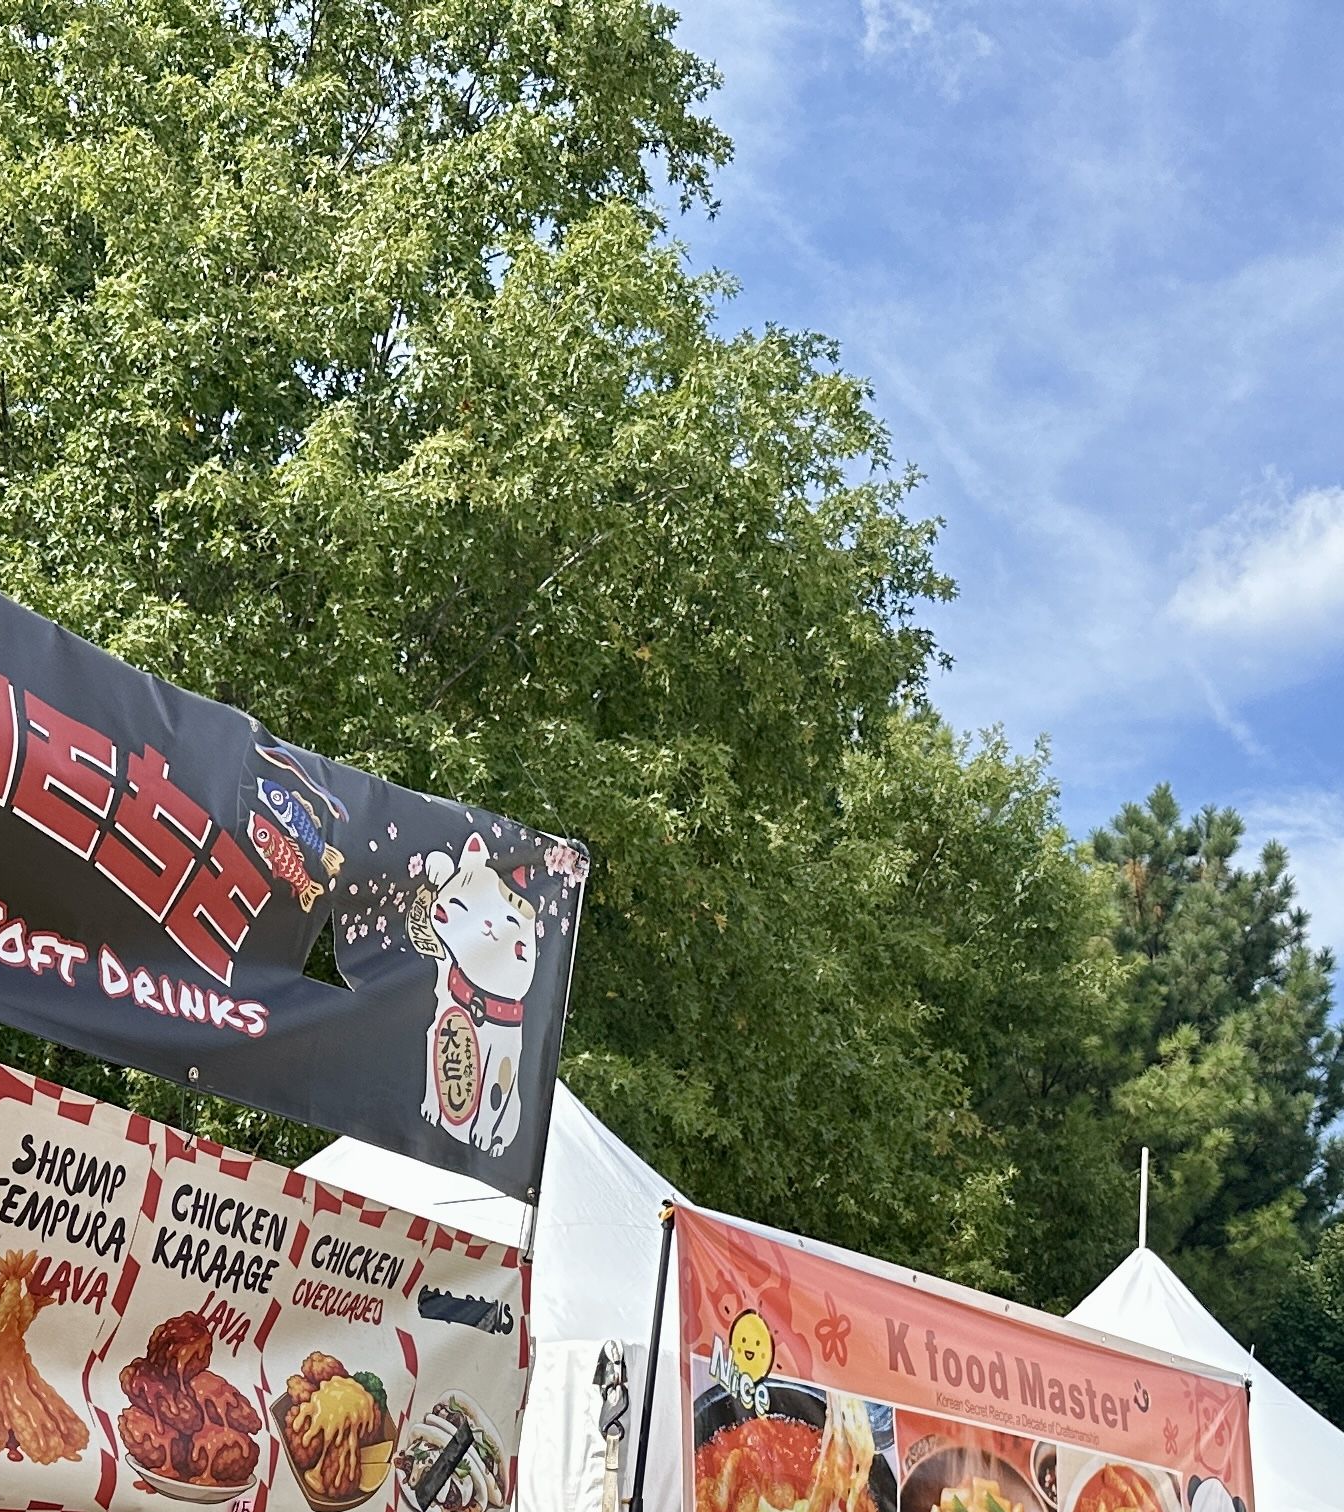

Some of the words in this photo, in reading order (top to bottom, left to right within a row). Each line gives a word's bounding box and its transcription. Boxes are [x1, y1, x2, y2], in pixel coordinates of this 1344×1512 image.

[98, 947, 268, 1035] DRINKS
[11, 1134, 128, 1204] SHRIMP
[170, 1183, 290, 1253] CHICKEN
[28, 1256, 109, 1316] LAVA
[151, 1226, 282, 1296] KARAAGE
[310, 1234, 405, 1291] CHICKEN
[197, 1290, 253, 1358] LAVA
[293, 1278, 384, 1326] OVERLOADED
[709, 1332, 771, 1419] Nice
[885, 1318, 917, 1377] K
[924, 1329, 1010, 1401] food
[1015, 1356, 1133, 1433] Master
[936, 1392, 964, 1411] Korean
[964, 1399, 988, 1418] Secret
